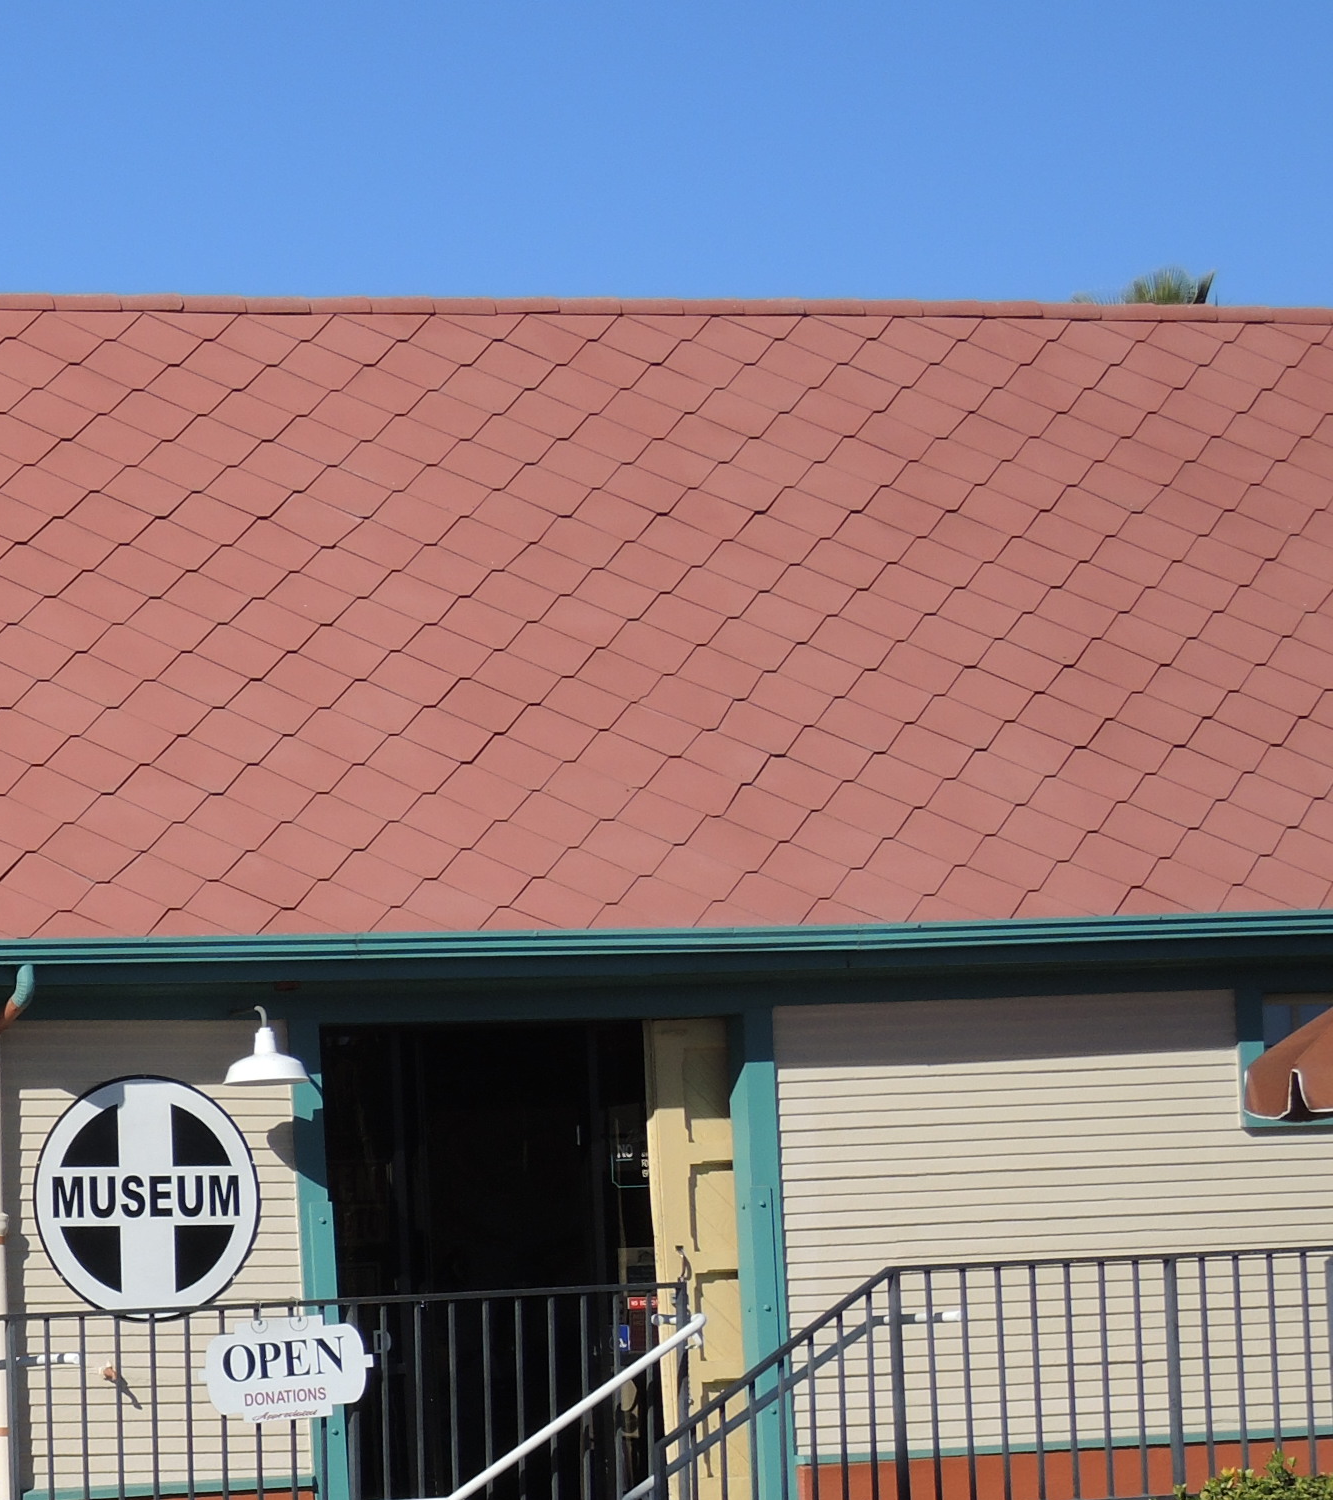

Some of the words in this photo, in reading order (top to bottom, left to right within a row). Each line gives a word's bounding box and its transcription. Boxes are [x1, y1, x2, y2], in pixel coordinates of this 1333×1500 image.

[52, 1174, 241, 1219] MUSEUM
[222, 1335, 344, 1383] OPEN
[244, 1386, 327, 1407] DONATIONS
